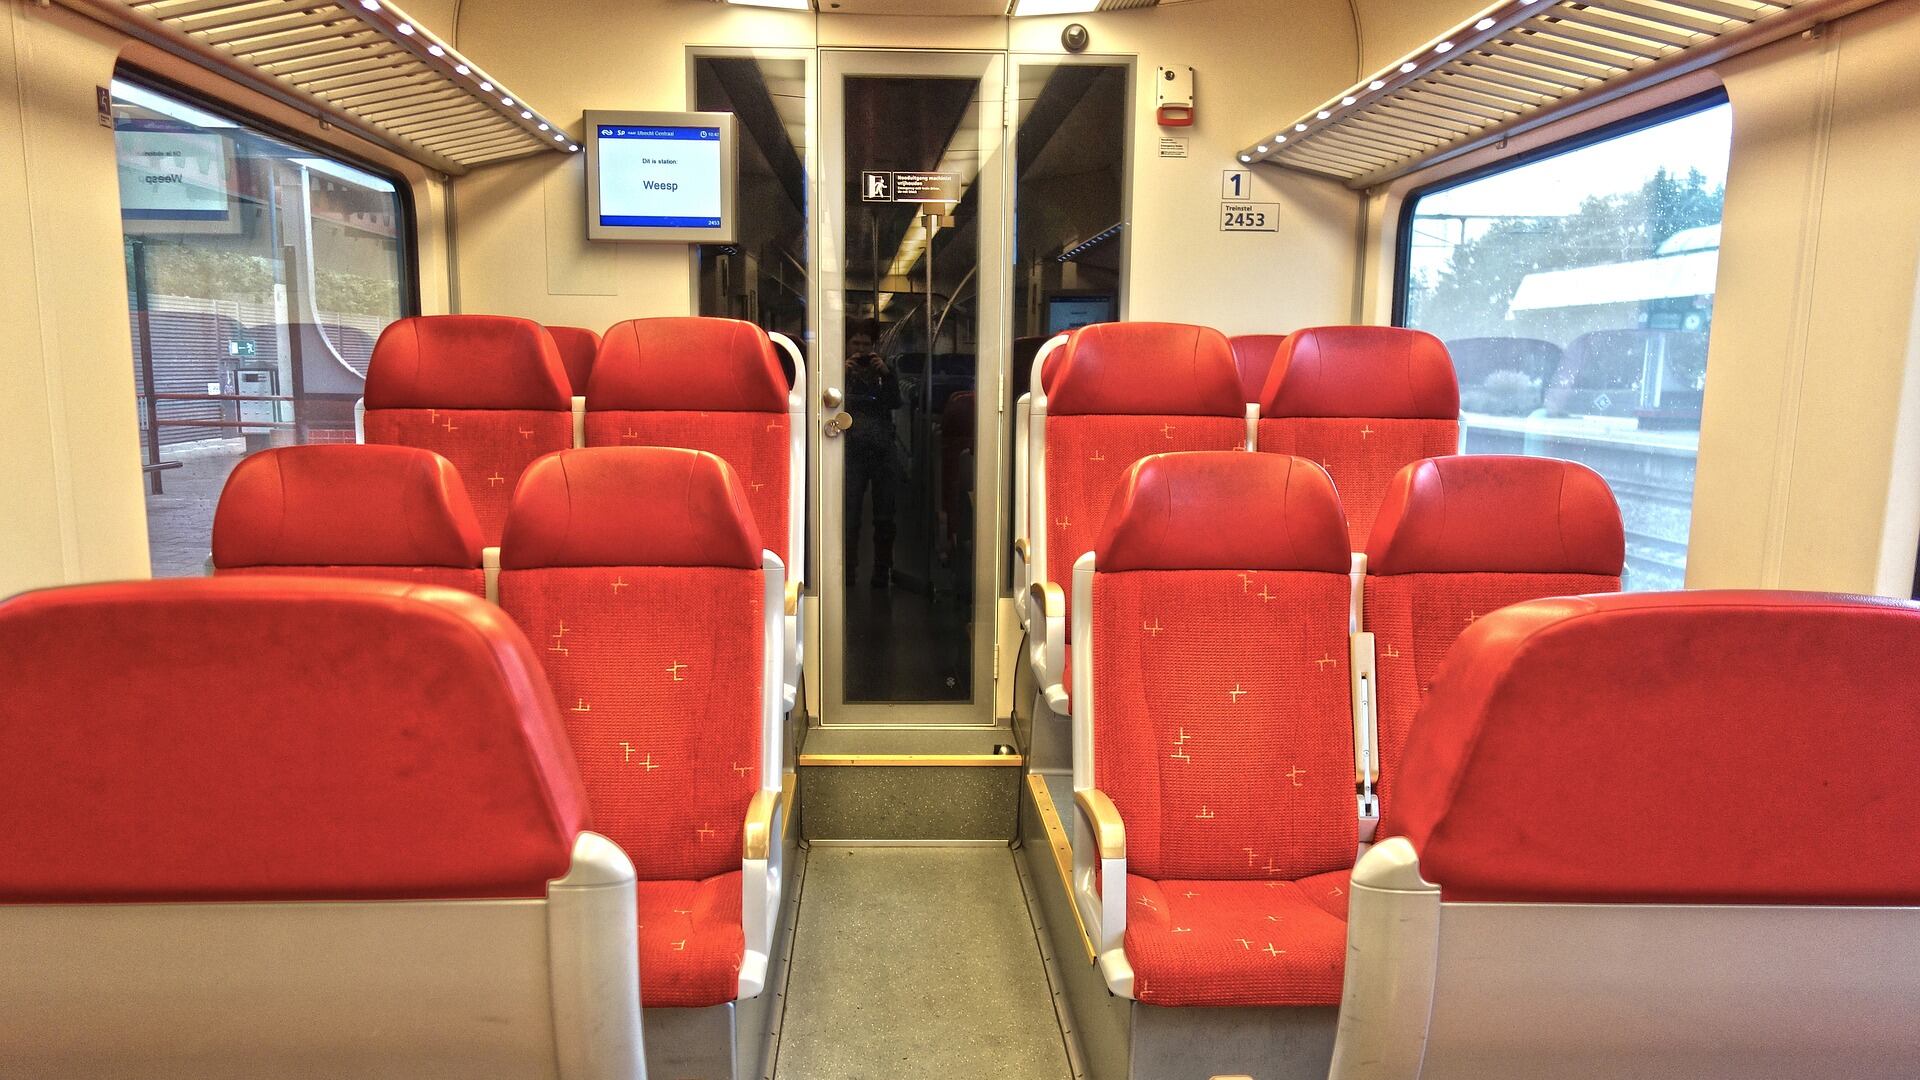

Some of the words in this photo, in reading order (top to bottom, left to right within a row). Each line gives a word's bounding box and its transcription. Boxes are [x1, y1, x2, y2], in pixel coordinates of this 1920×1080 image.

[643, 180, 678, 192] Weesp
[1230, 173, 1241, 196] 1
[1224, 212, 1265, 227] 2453
